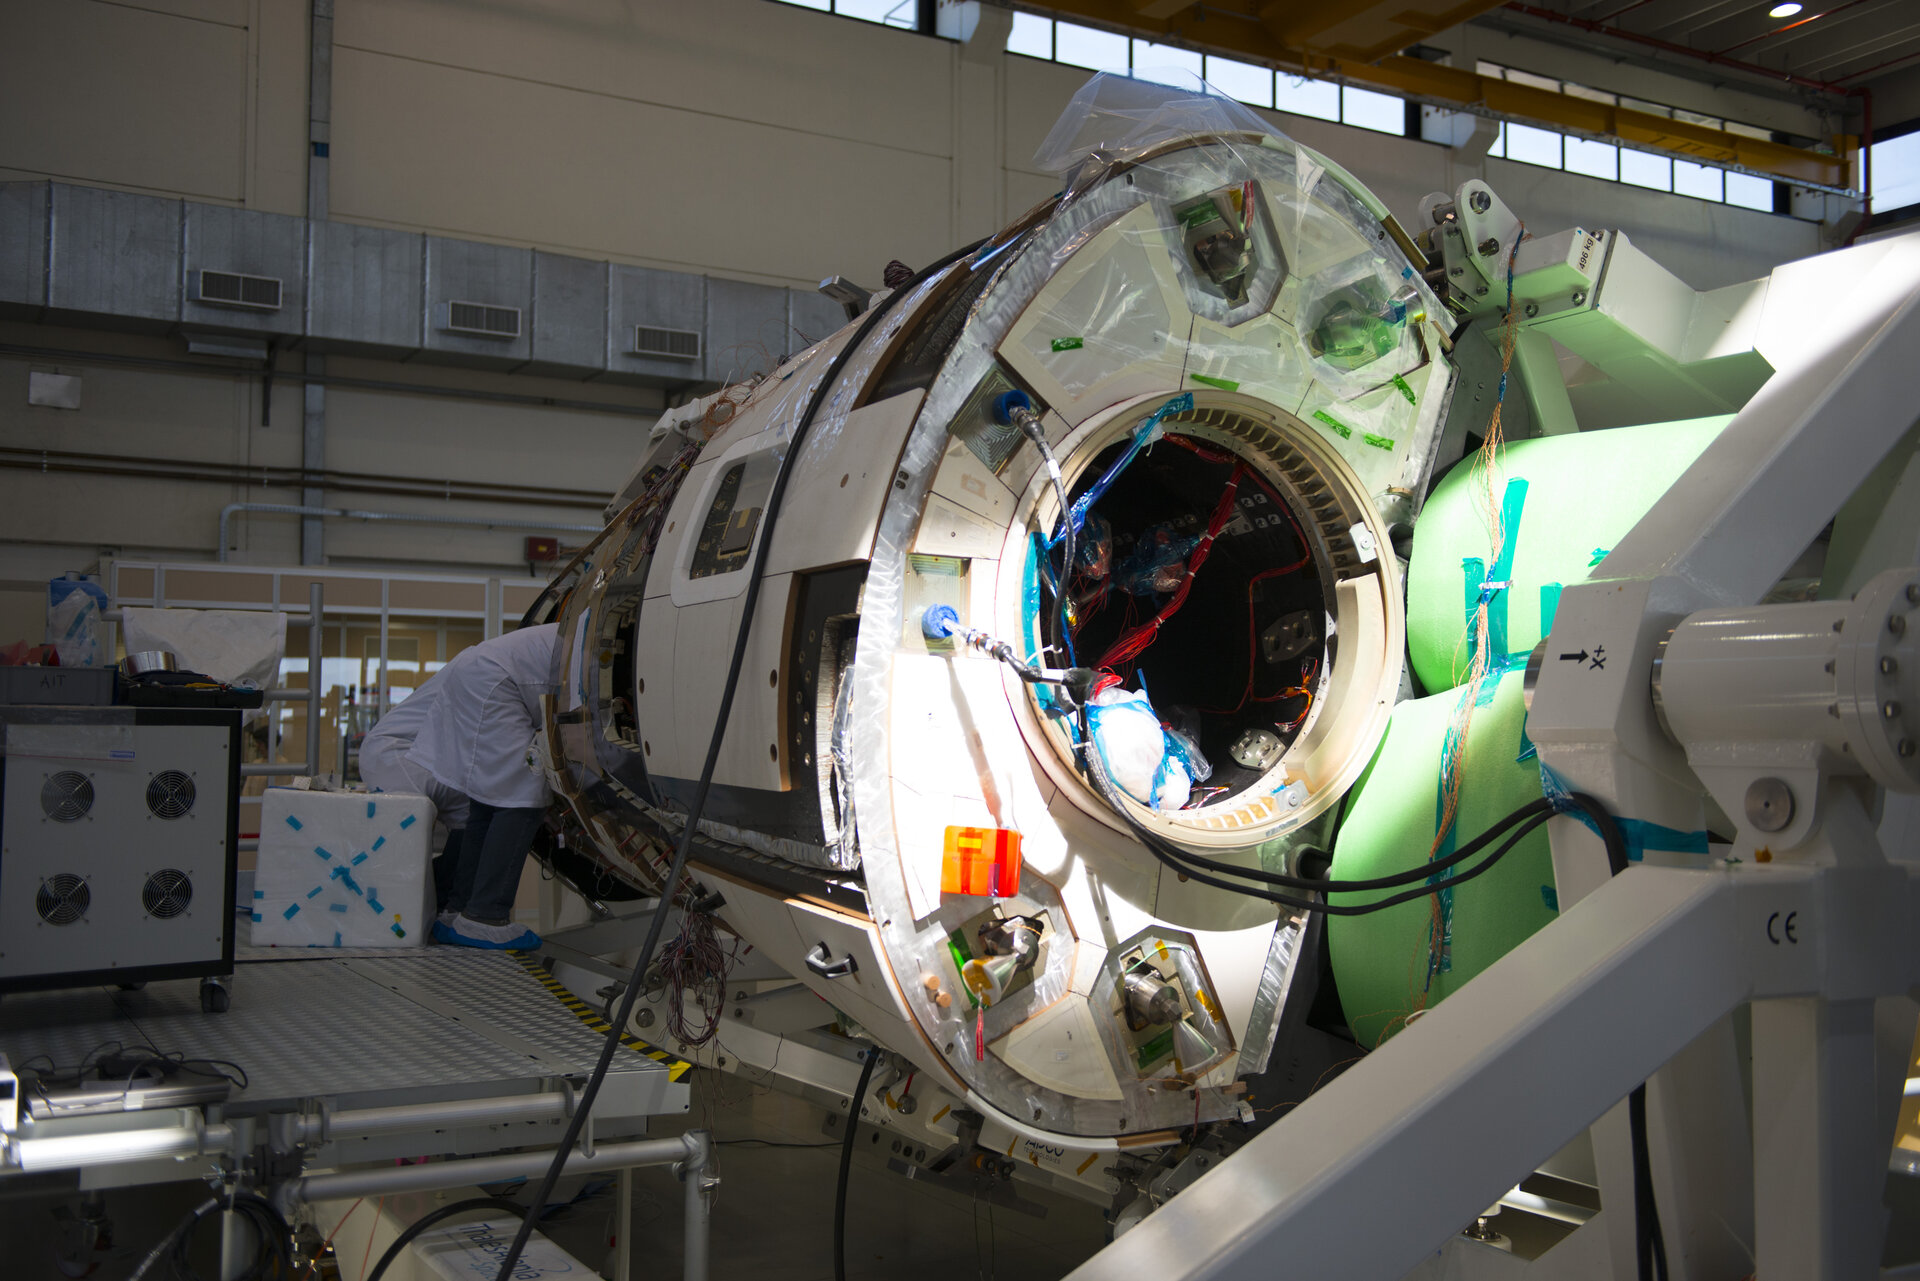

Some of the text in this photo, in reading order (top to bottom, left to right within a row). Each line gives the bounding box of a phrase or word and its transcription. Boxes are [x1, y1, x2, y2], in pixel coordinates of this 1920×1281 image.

[1579, 238, 1594, 270] 496 kg
[1767, 910, 1798, 945] CE
